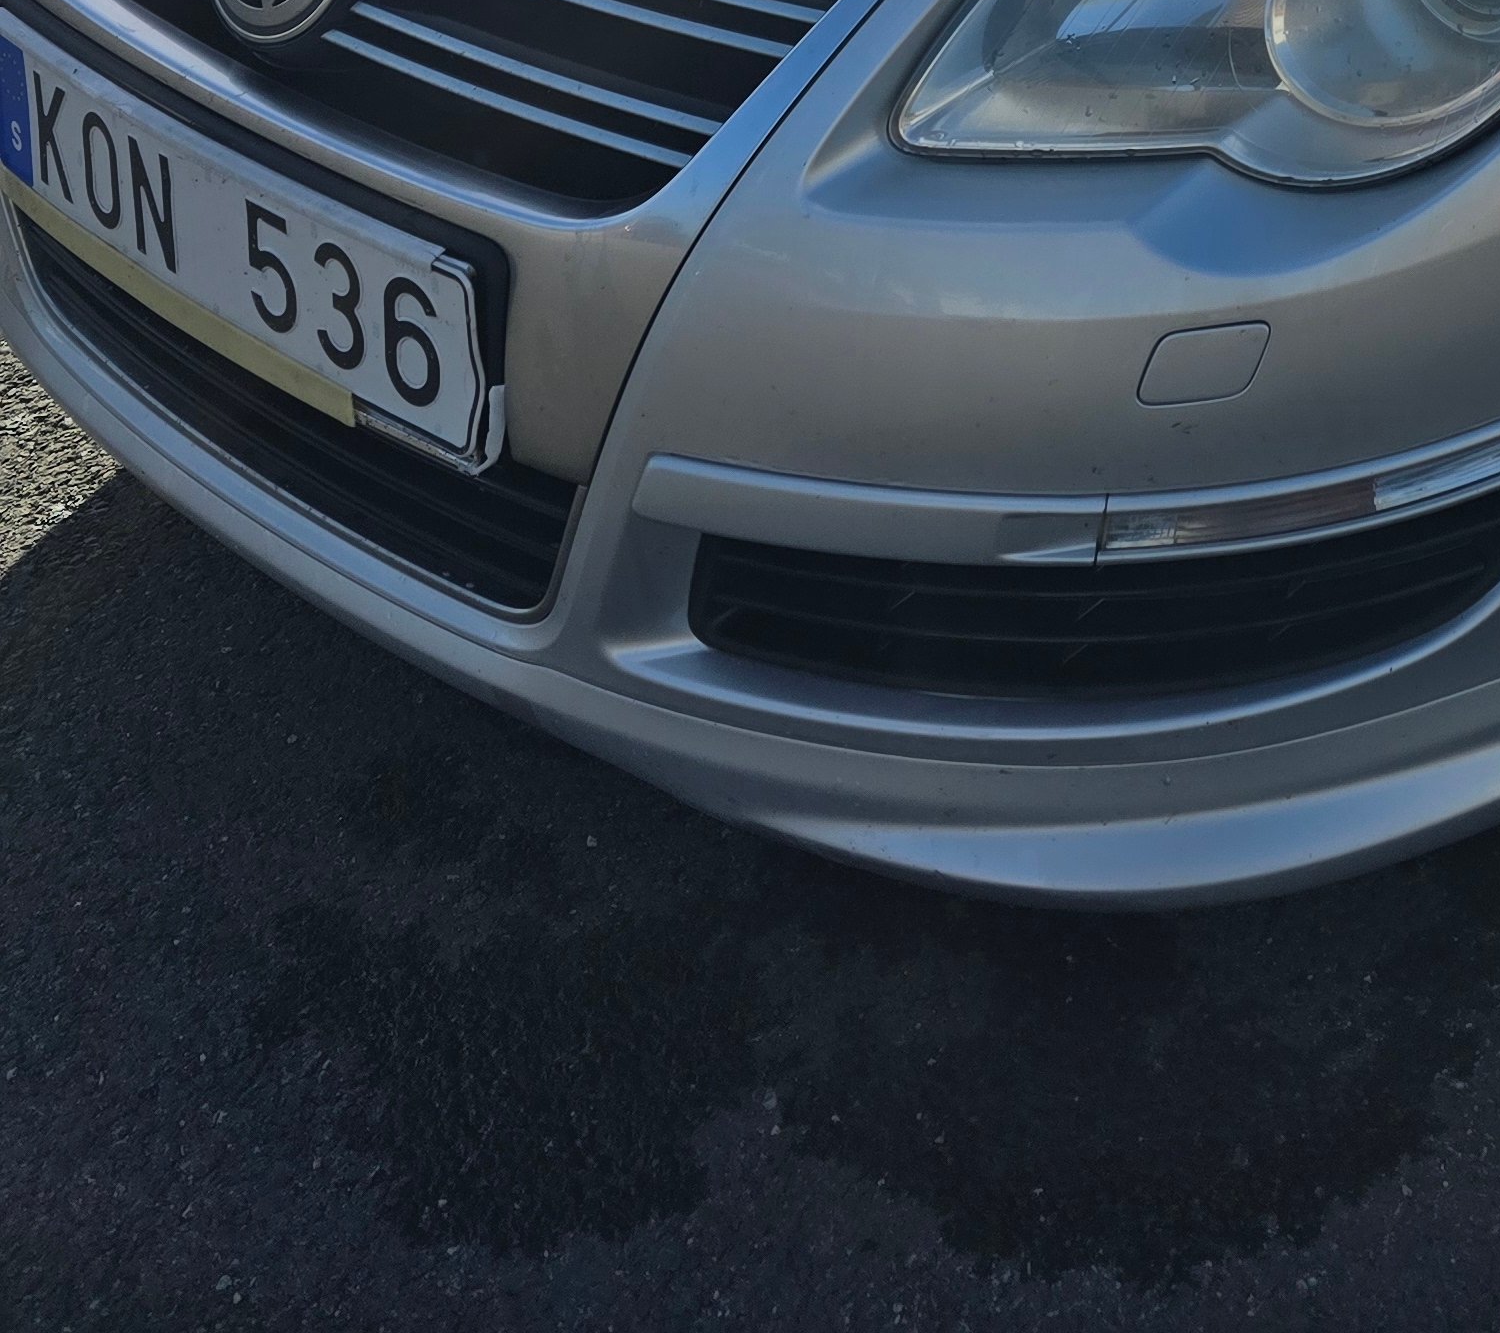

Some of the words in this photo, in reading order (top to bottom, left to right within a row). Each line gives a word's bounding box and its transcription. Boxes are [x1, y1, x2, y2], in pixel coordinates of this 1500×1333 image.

[11, 120, 22, 151] S
[33, 71, 177, 274] KON
[245, 198, 441, 407] 536
